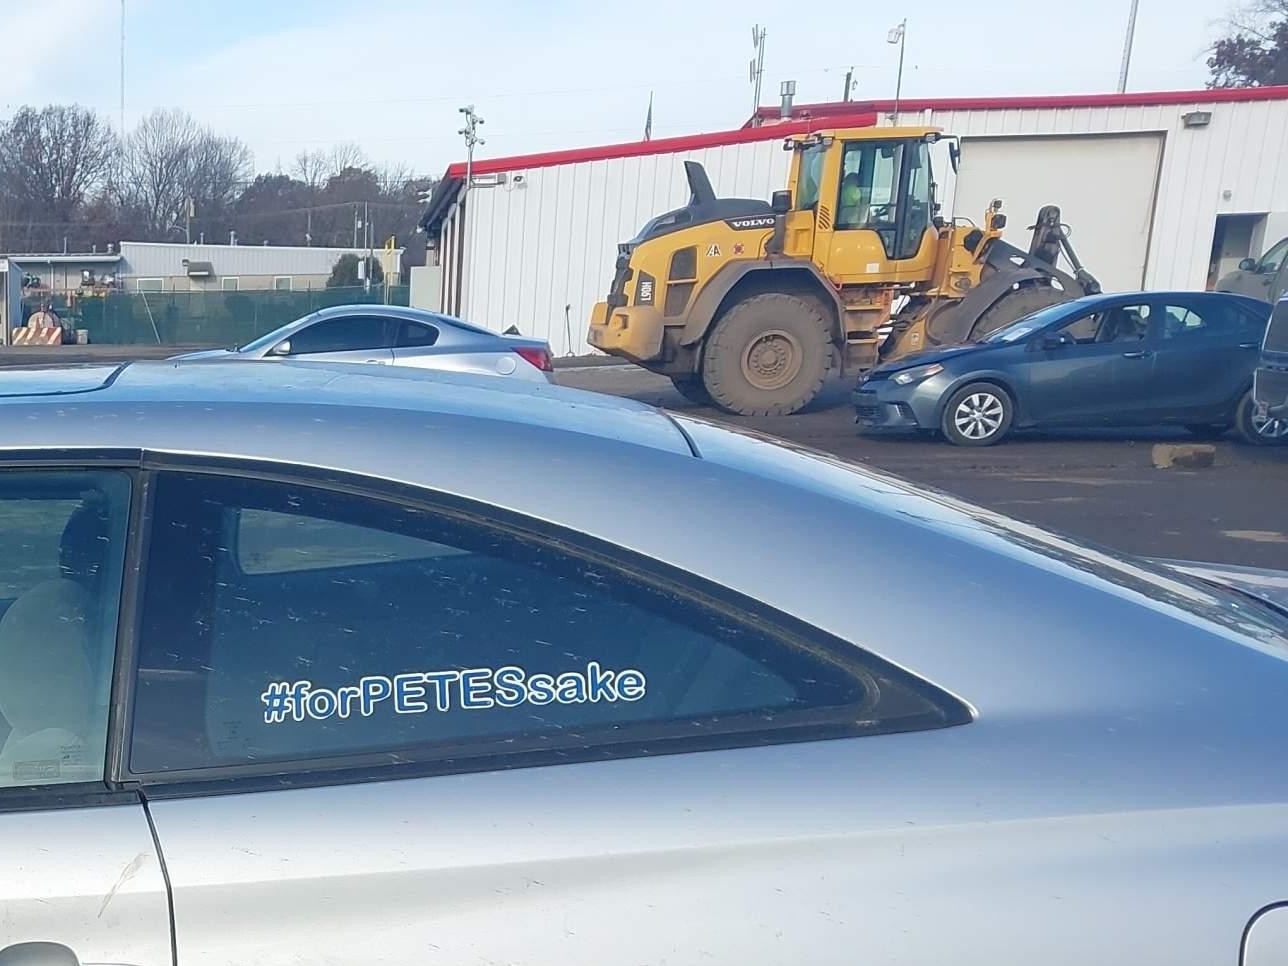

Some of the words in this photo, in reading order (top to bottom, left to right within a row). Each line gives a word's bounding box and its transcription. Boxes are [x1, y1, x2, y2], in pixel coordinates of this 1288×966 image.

[732, 217, 775, 228] VOLVO
[640, 281, 652, 301] L90H
[261, 662, 646, 723] #forPETESsake
